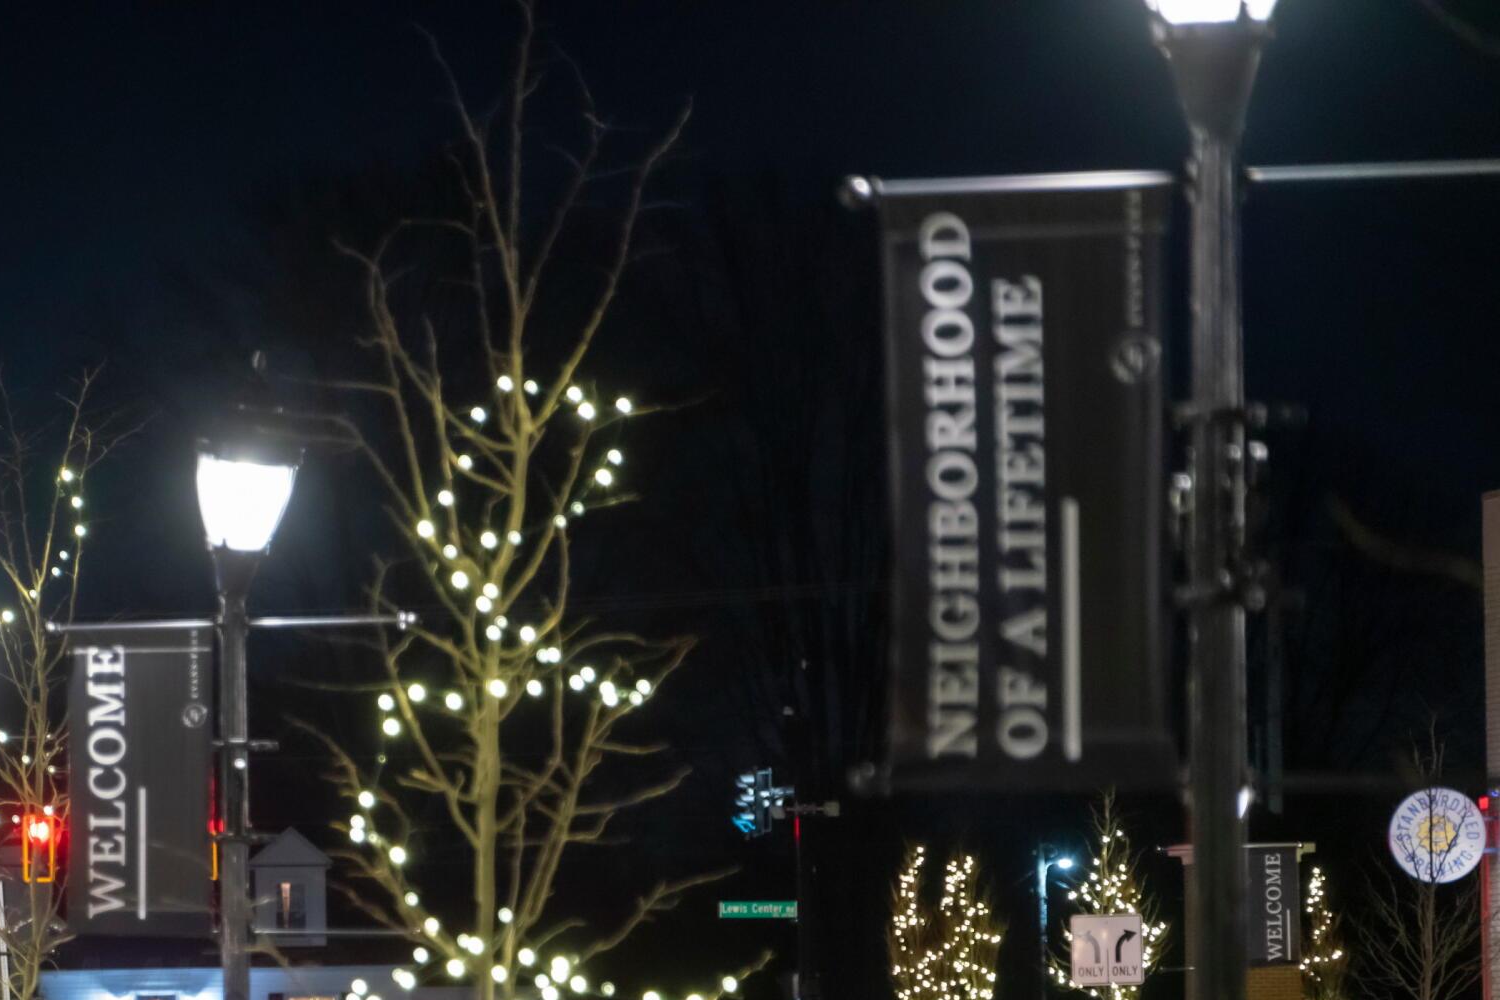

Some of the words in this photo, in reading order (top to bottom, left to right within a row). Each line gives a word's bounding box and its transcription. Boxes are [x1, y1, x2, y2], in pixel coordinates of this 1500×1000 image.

[992, 274, 1047, 592] LIFETIME
[920, 212, 980, 758] NEIGHBORHOOD
[1002, 609, 1047, 659] A
[998, 665, 1049, 759] OF
[87, 645, 126, 919] WELCOME
[722, 903, 748, 914] Lewis
[752, 903, 782, 914] Center
[1265, 853, 1283, 961] WELCOME
[1078, 966, 1104, 977] ONLY
[1112, 966, 1138, 976] ONLY
